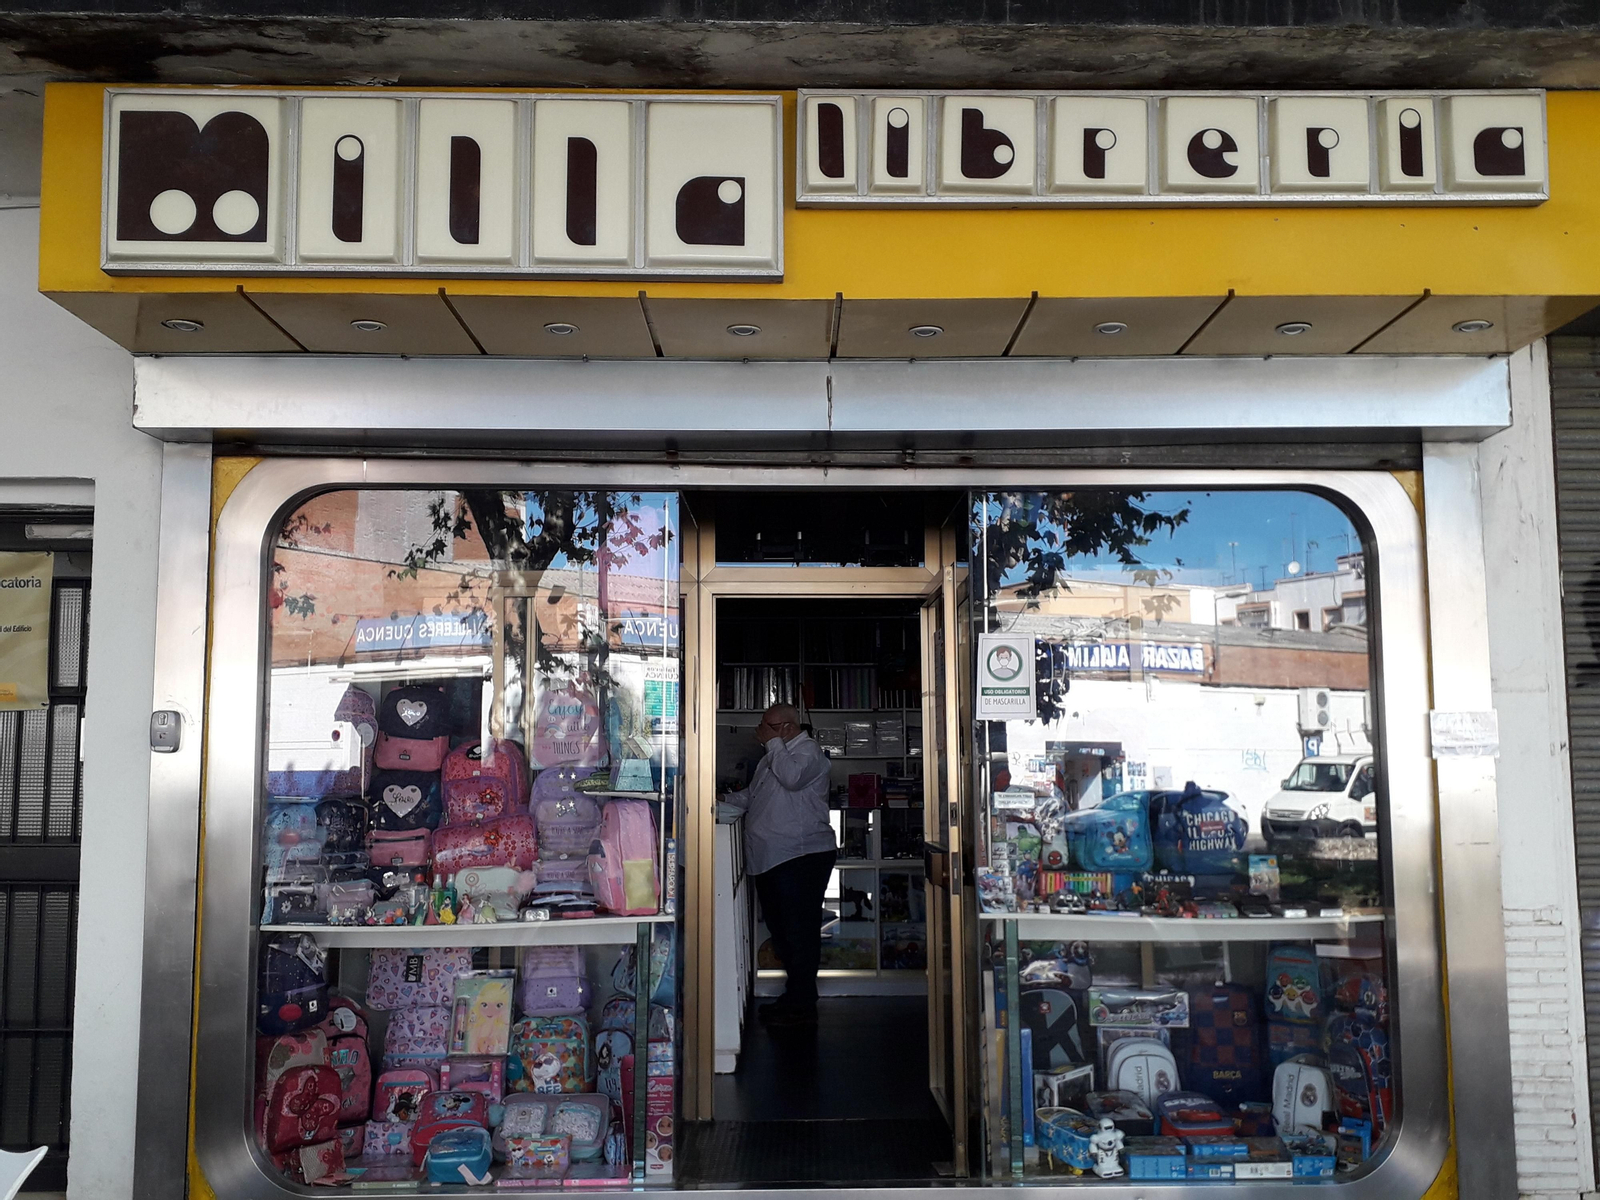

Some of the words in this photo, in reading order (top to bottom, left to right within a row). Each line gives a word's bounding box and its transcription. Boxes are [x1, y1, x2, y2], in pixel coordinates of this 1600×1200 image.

[0, 575, 42, 588] catoria
[13, 625, 32, 633] Edificio
[553, 741, 580, 755] THINGS
[1186, 810, 1236, 826] CHICAGO
[1188, 836, 1237, 852] HIGHWAY
[1283, 1074, 1295, 1109] Madrid
